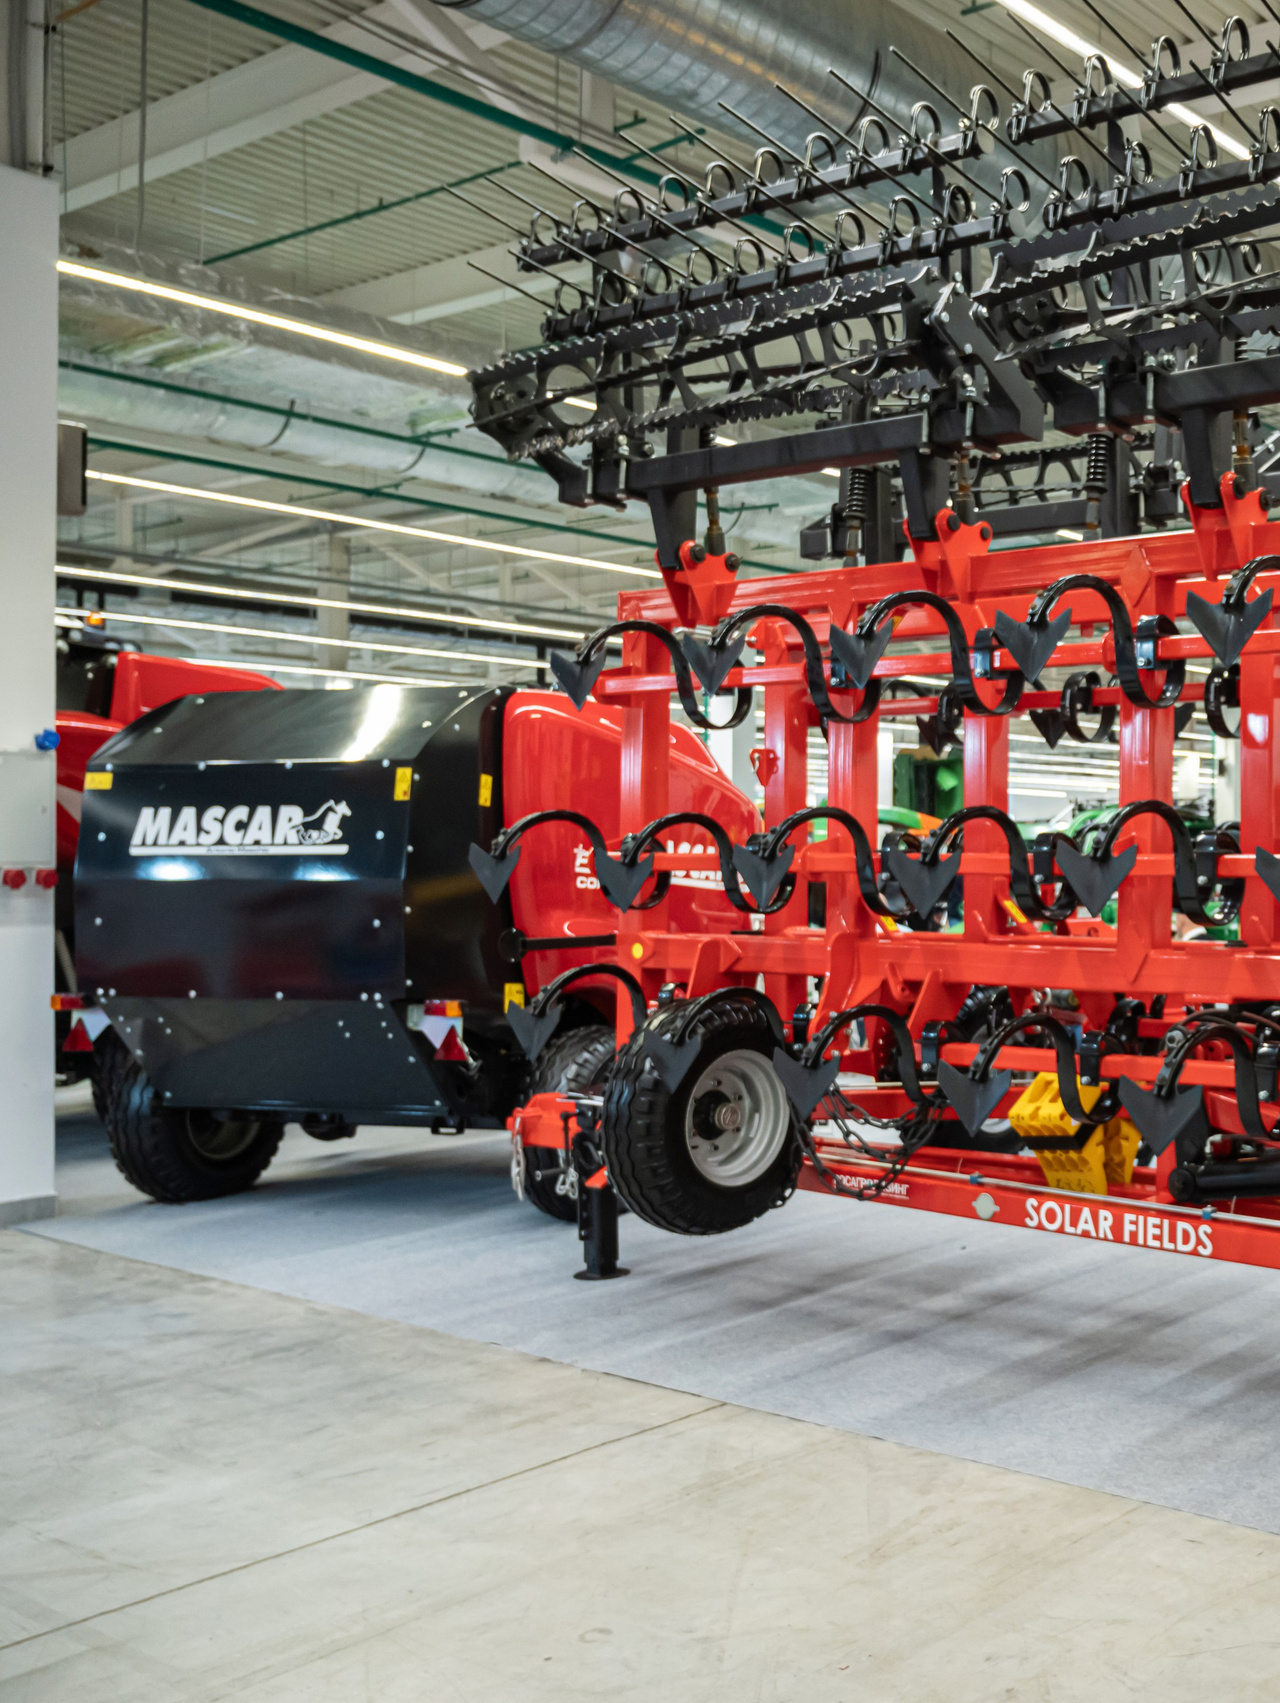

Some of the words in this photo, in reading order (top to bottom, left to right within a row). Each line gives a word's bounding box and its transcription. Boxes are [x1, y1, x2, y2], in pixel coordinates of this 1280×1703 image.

[130, 804, 304, 846] MASCAR
[1024, 1197, 1114, 1241] SOLAR
[1123, 1212, 1213, 1256] FIELDS
